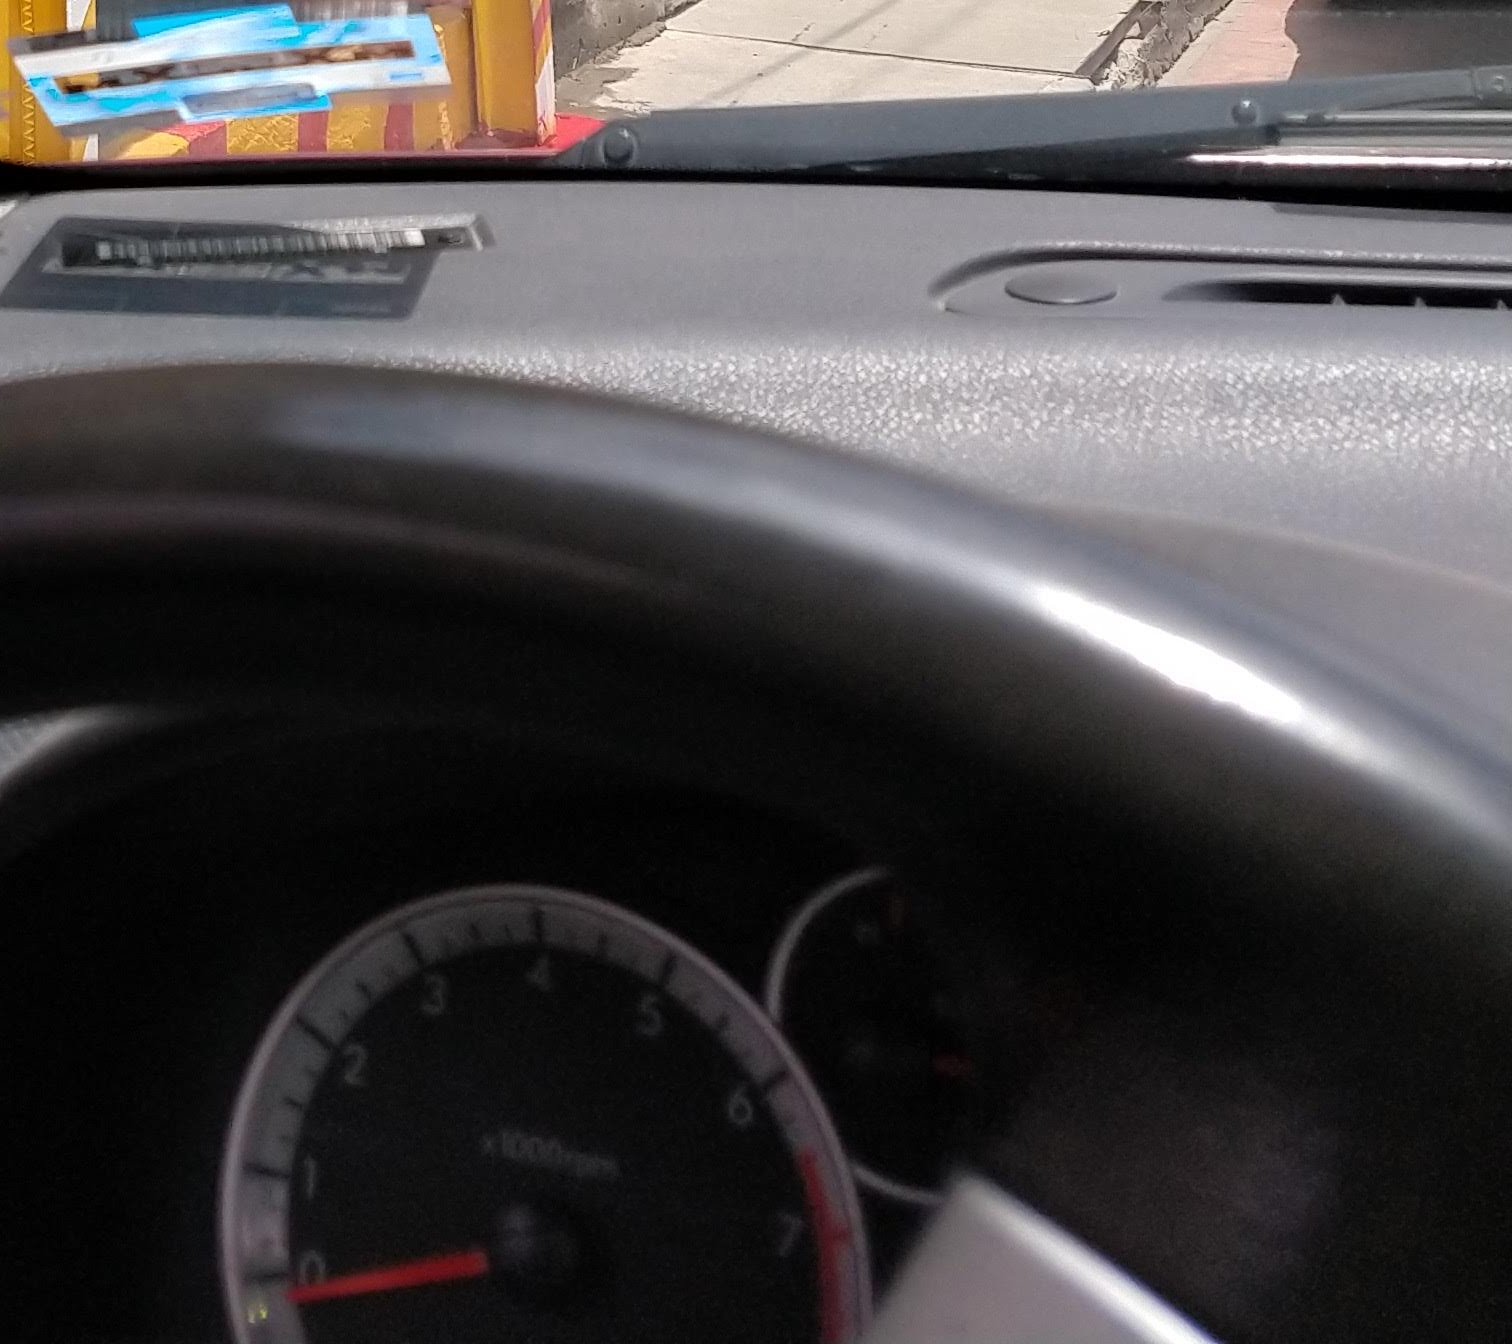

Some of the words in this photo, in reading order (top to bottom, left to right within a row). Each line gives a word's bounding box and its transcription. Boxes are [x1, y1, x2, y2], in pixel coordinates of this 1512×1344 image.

[420, 974, 448, 1015] 3
[636, 994, 665, 1038] 5
[341, 1045, 370, 1087] 2
[727, 1087, 755, 1128] 6
